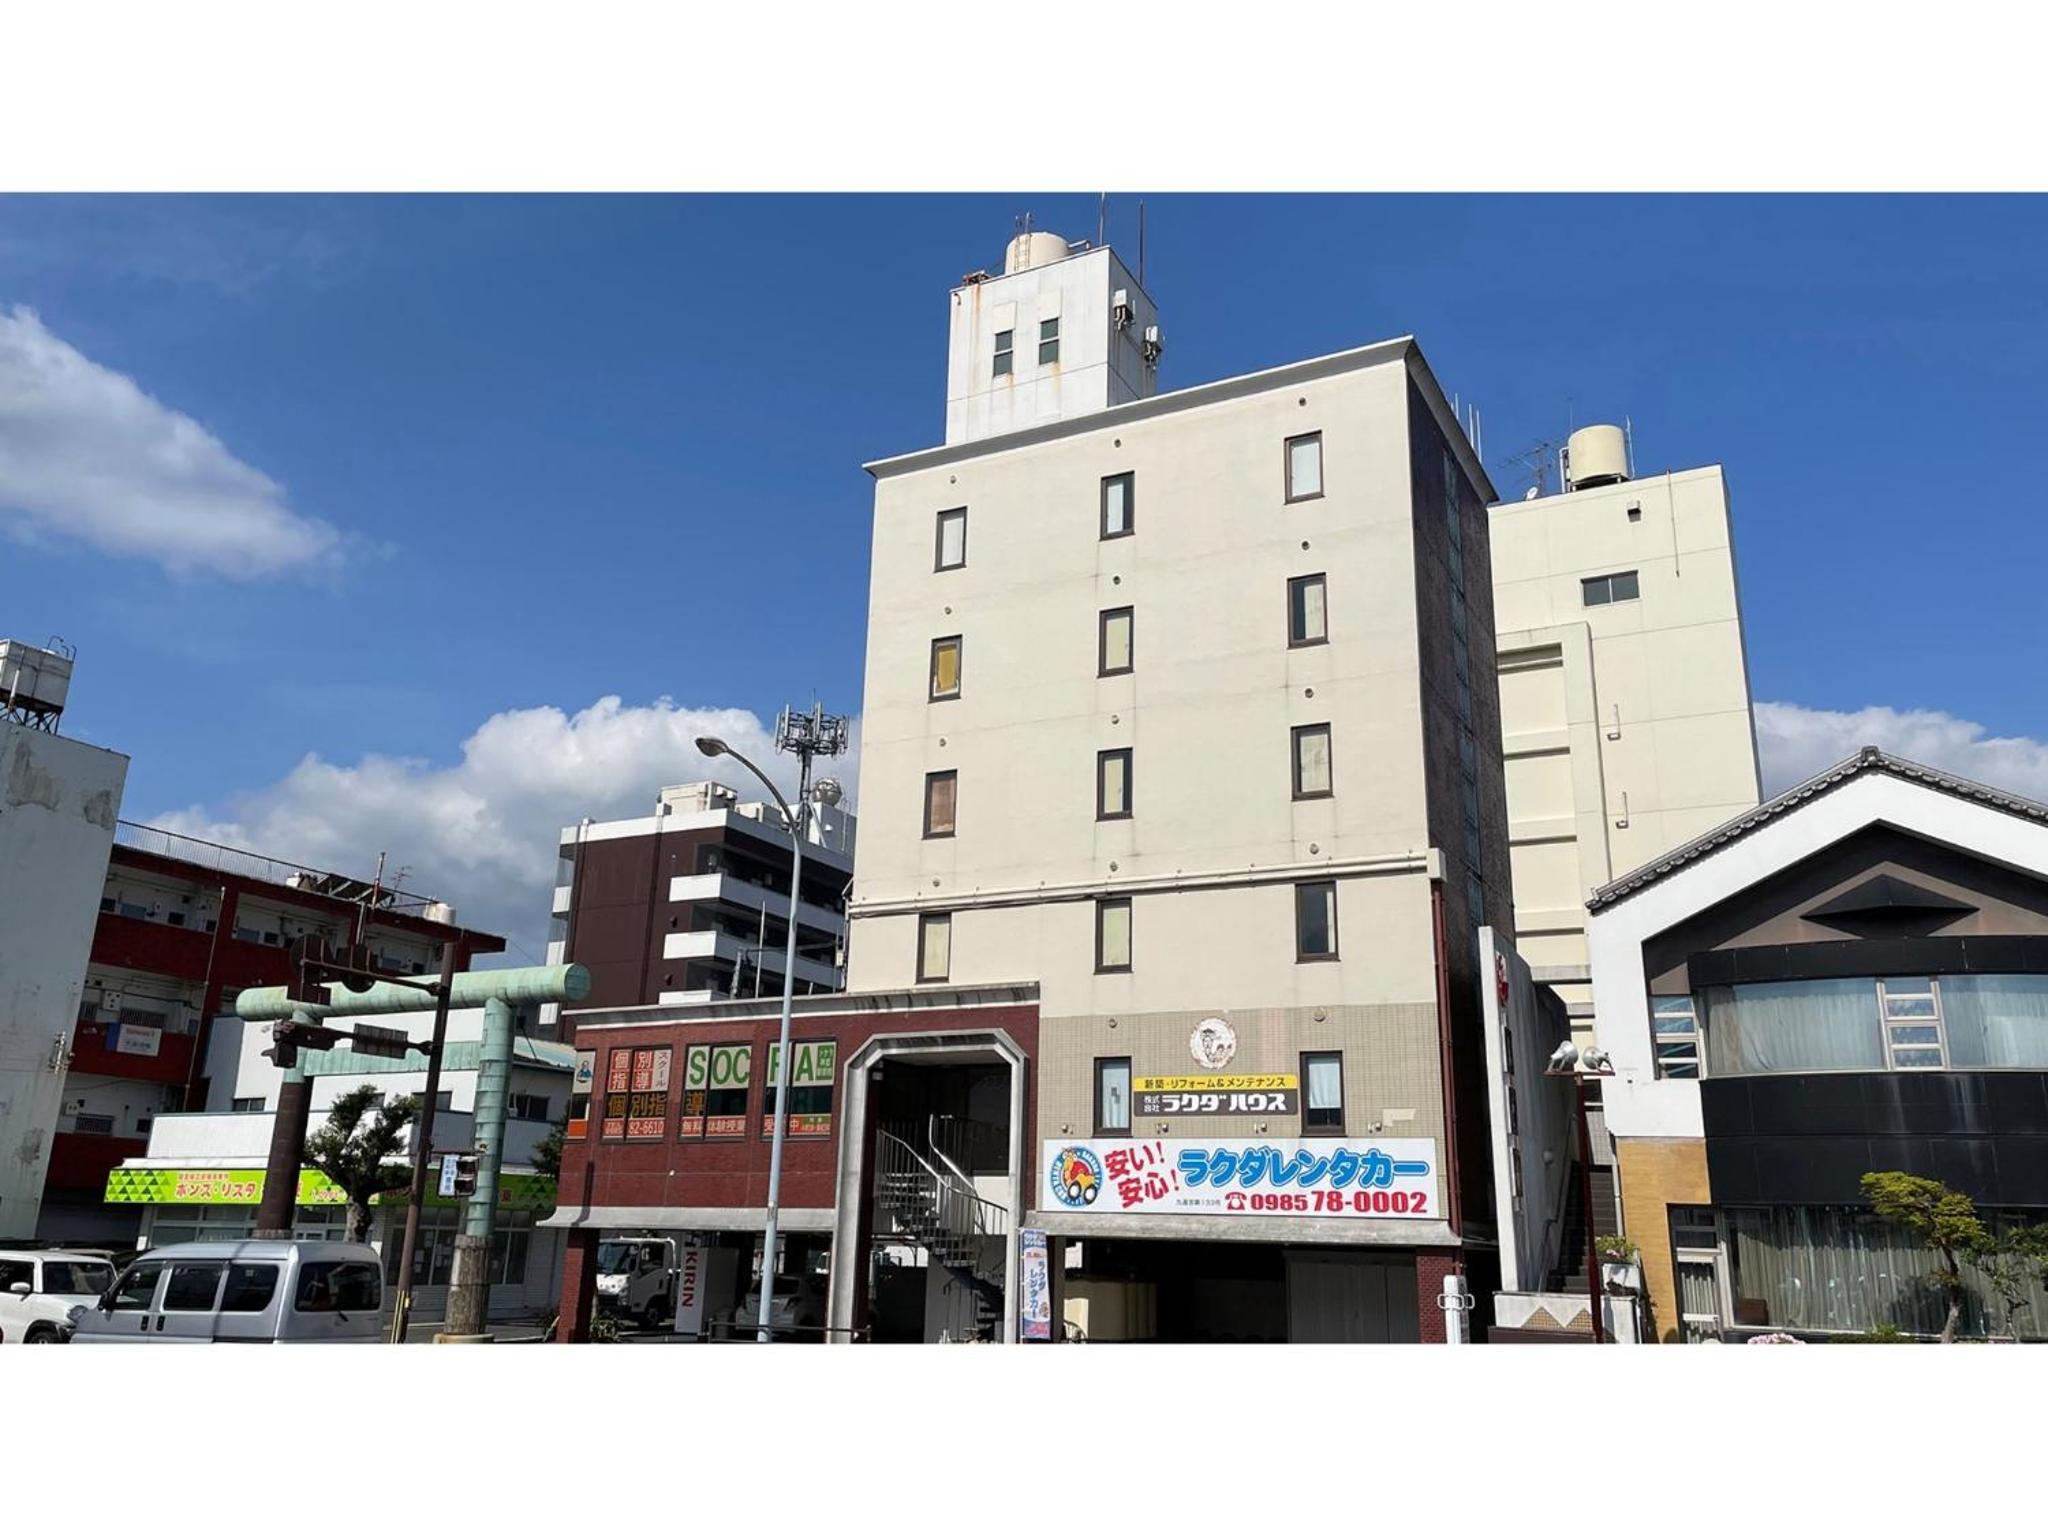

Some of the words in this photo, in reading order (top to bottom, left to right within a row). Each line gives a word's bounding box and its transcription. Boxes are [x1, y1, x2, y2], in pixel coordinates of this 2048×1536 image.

[1162, 1093, 1287, 1112] ラクダハウス
[1104, 1141, 1165, 1179] 安い!
[1177, 1146, 1430, 1190] ラクダレンタカー
[1117, 1168, 1180, 1208] 安心!
[1249, 1193, 1309, 1212] 0985
[1311, 1190, 1428, 1214] 78-0002
[682, 1252, 699, 1307] KIRIN
